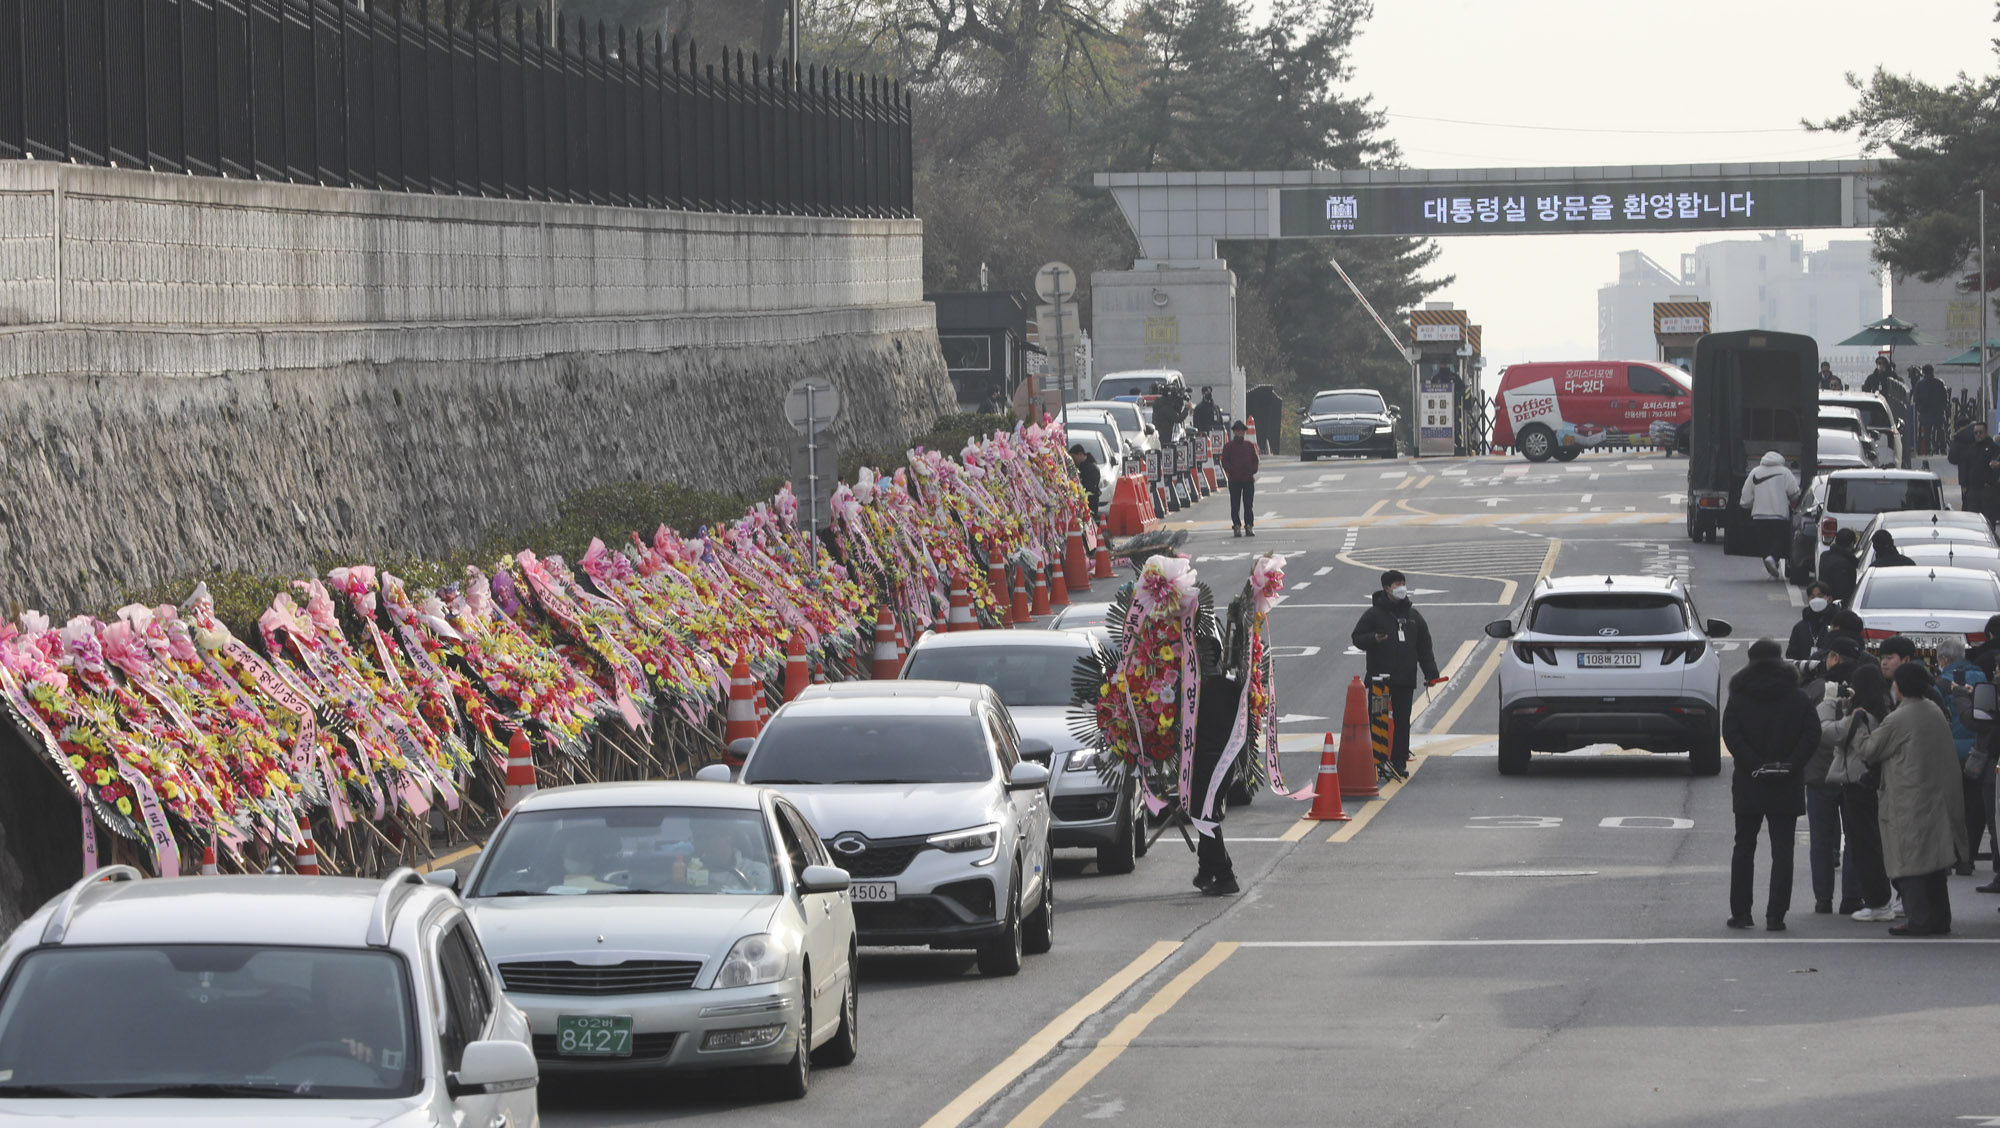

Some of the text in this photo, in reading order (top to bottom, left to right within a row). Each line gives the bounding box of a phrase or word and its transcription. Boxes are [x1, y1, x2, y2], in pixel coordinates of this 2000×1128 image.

[1423, 190, 1754, 224] 대통령실 방문을 환영합니다
[1565, 369, 1613, 379] 오피스디포엔
[1564, 379, 1605, 393] 다~있다
[1512, 397, 1553, 415] Office
[1514, 404, 1554, 423] DEPOT
[1183, 615, 1198, 715] 윤석열
[1586, 654, 1637, 665] 108버 2101
[850, 884, 888, 900] 4506
[561, 1028, 629, 1051] 8427
